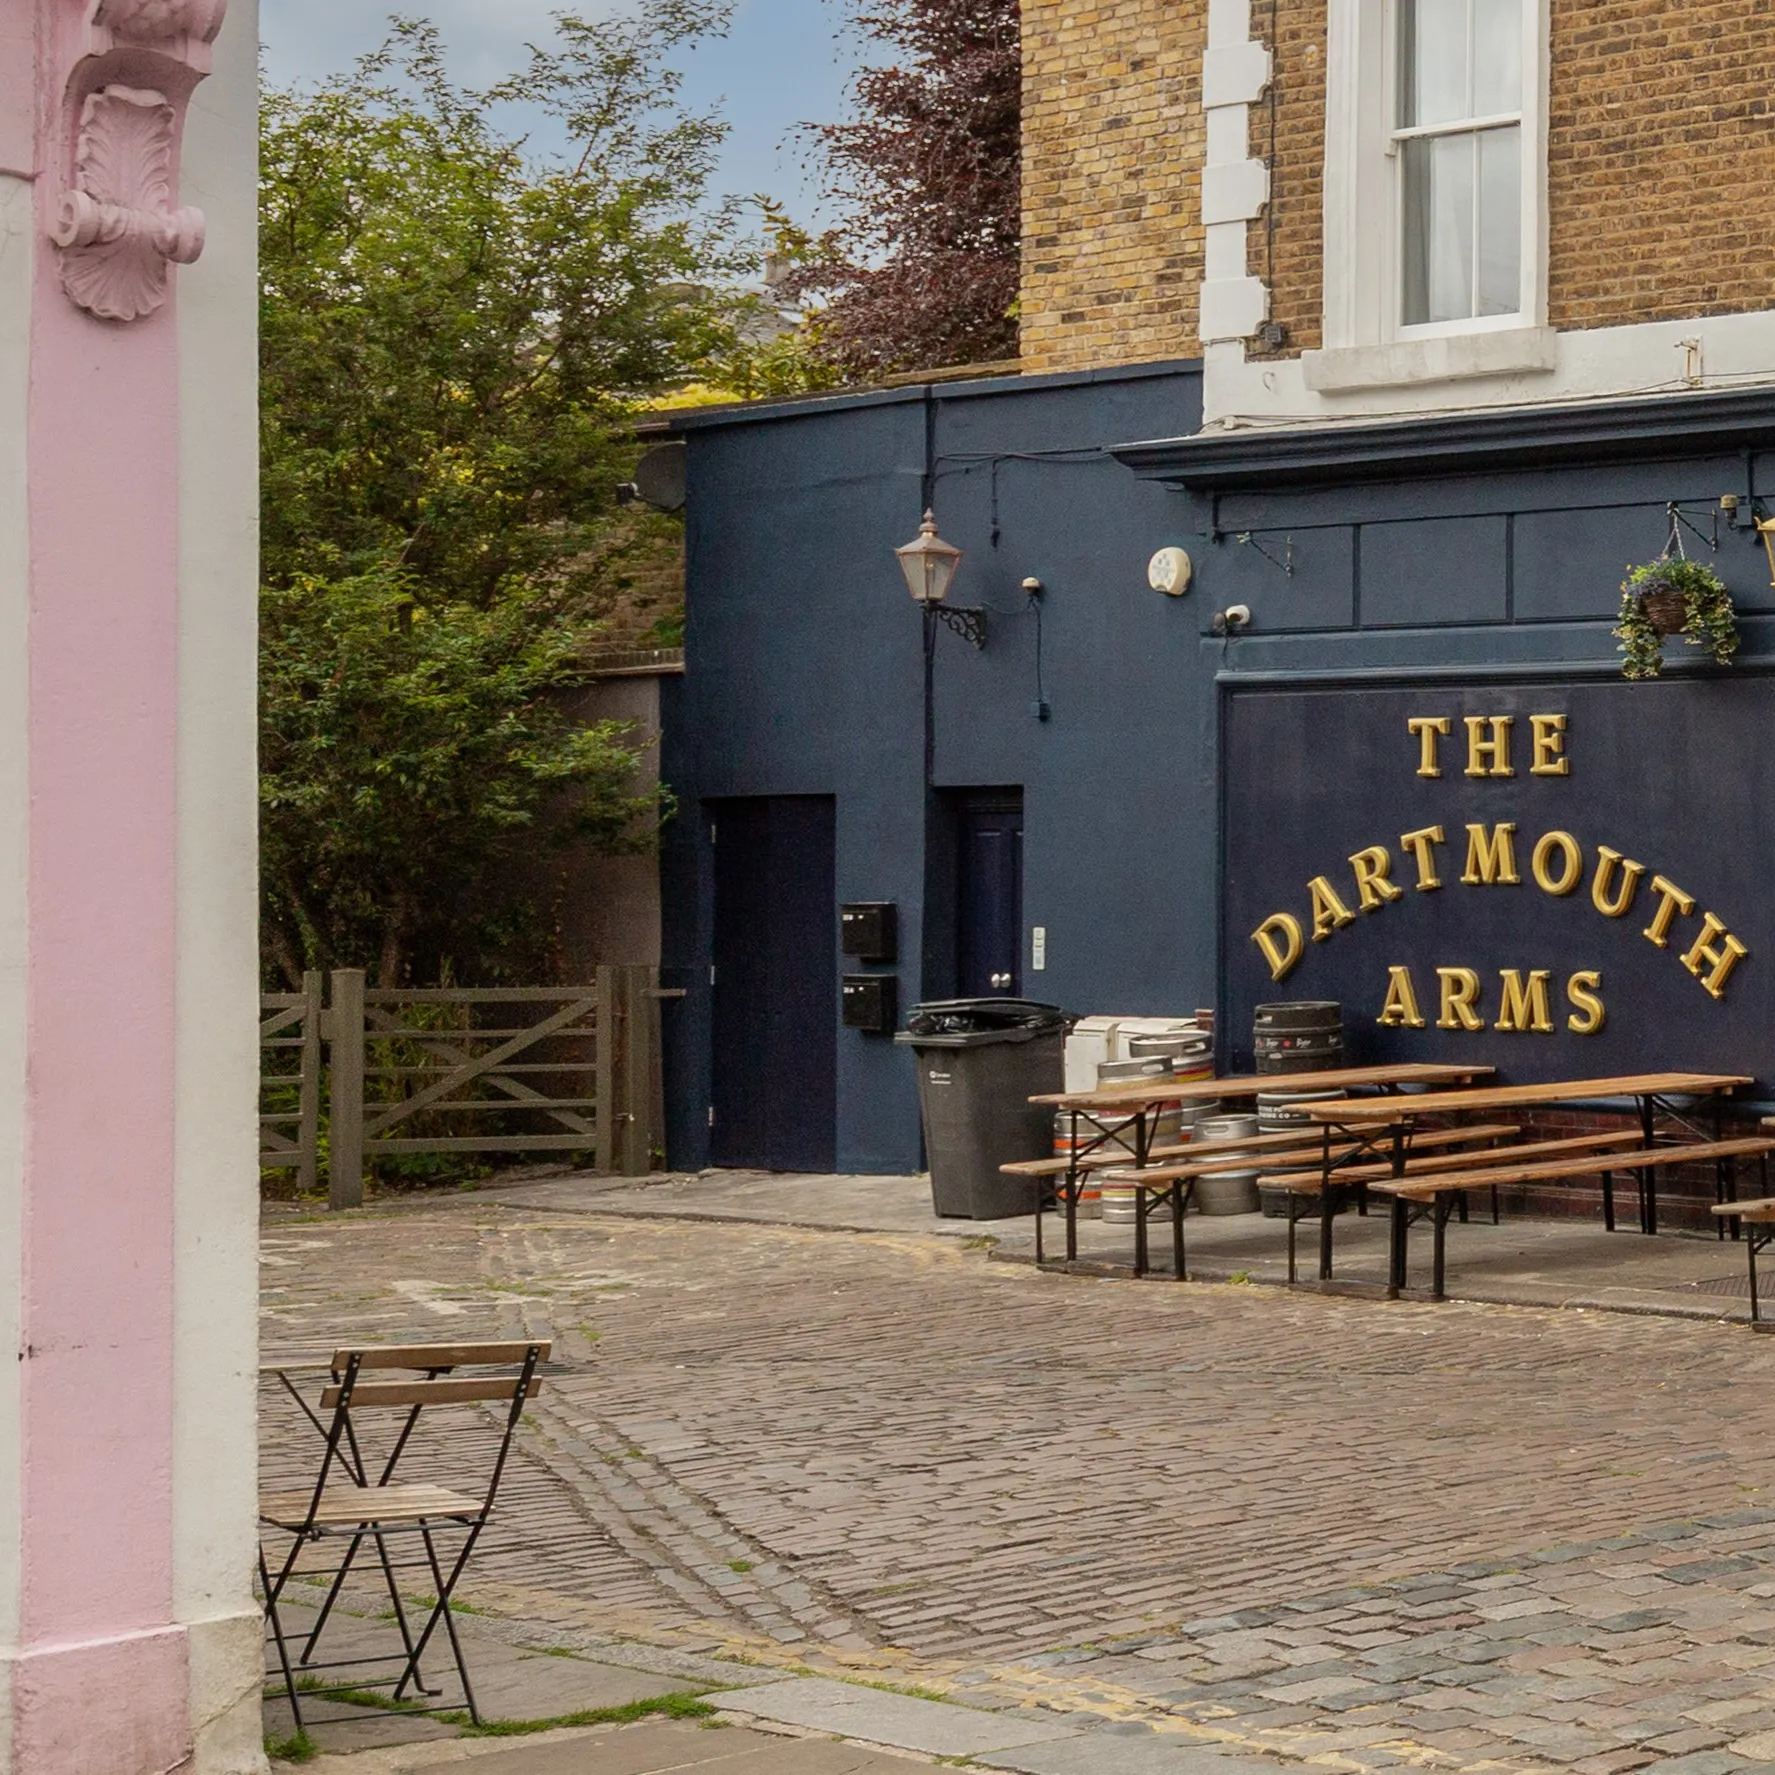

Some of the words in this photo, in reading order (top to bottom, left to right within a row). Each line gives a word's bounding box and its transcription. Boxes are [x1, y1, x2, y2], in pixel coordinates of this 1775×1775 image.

[1408, 713, 1570, 778] THE
[1251, 822, 1750, 1000] DARTMOUTH
[1376, 965, 1606, 1035] ARMS
